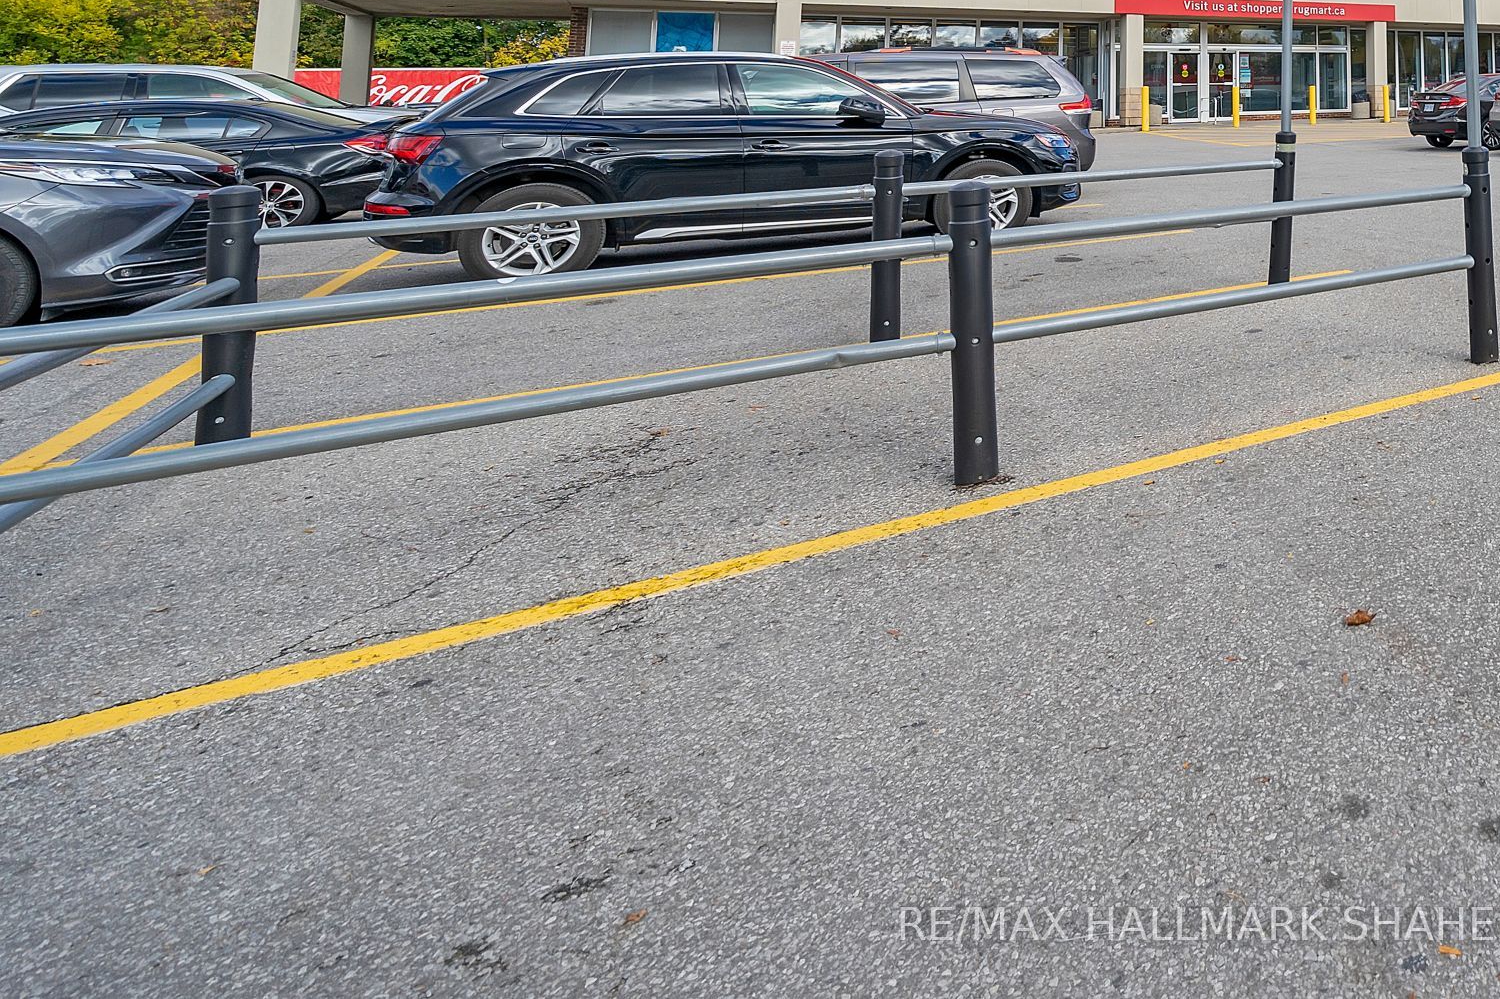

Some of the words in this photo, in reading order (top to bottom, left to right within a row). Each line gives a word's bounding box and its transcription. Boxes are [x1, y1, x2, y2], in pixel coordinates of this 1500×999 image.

[1183, 0, 1208, 11] Visit
[1212, 4, 1224, 12] us
[1227, 3, 1238, 12] at
[1241, 4, 1345, 16] shopperrugmart.ca
